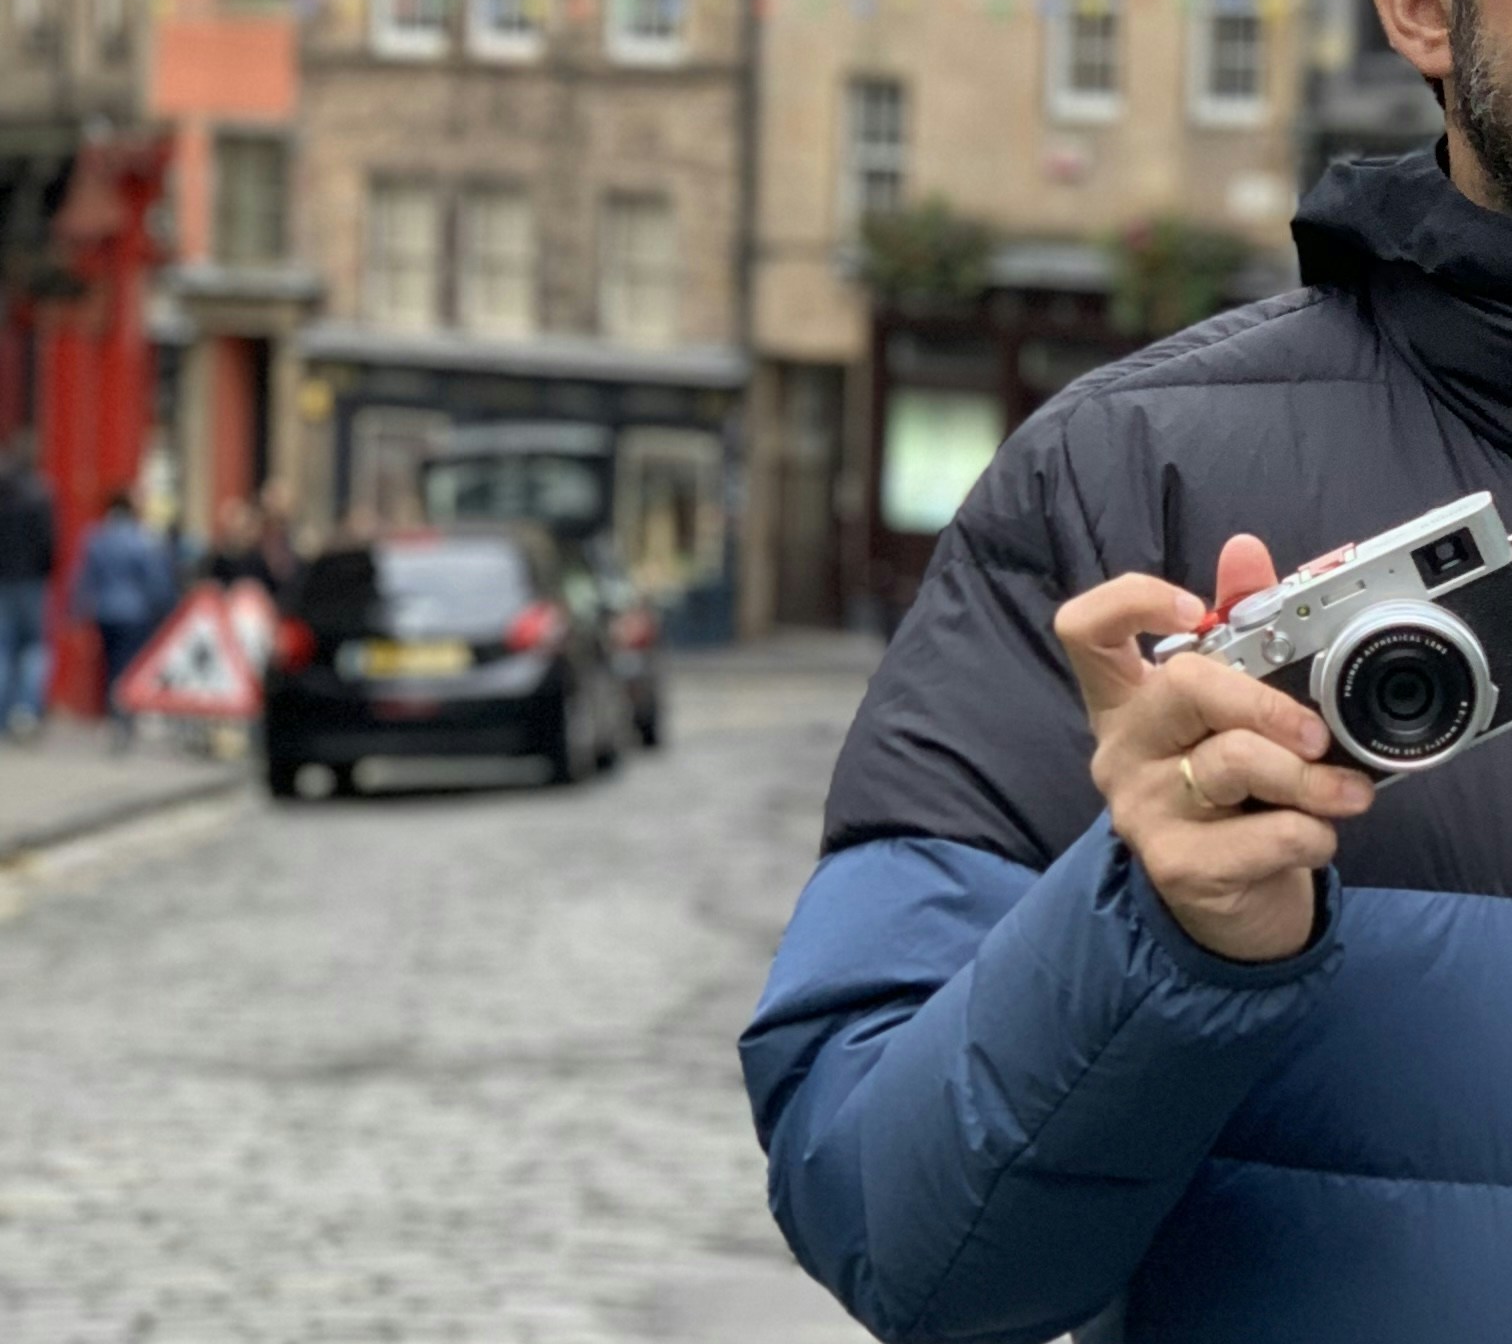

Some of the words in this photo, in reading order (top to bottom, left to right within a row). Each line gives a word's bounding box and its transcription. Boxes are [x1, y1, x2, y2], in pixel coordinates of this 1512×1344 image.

[1363, 634, 1421, 657] ASPHERICAL
[1424, 638, 1448, 655] LENS
[1371, 739, 1400, 755] SUPER
